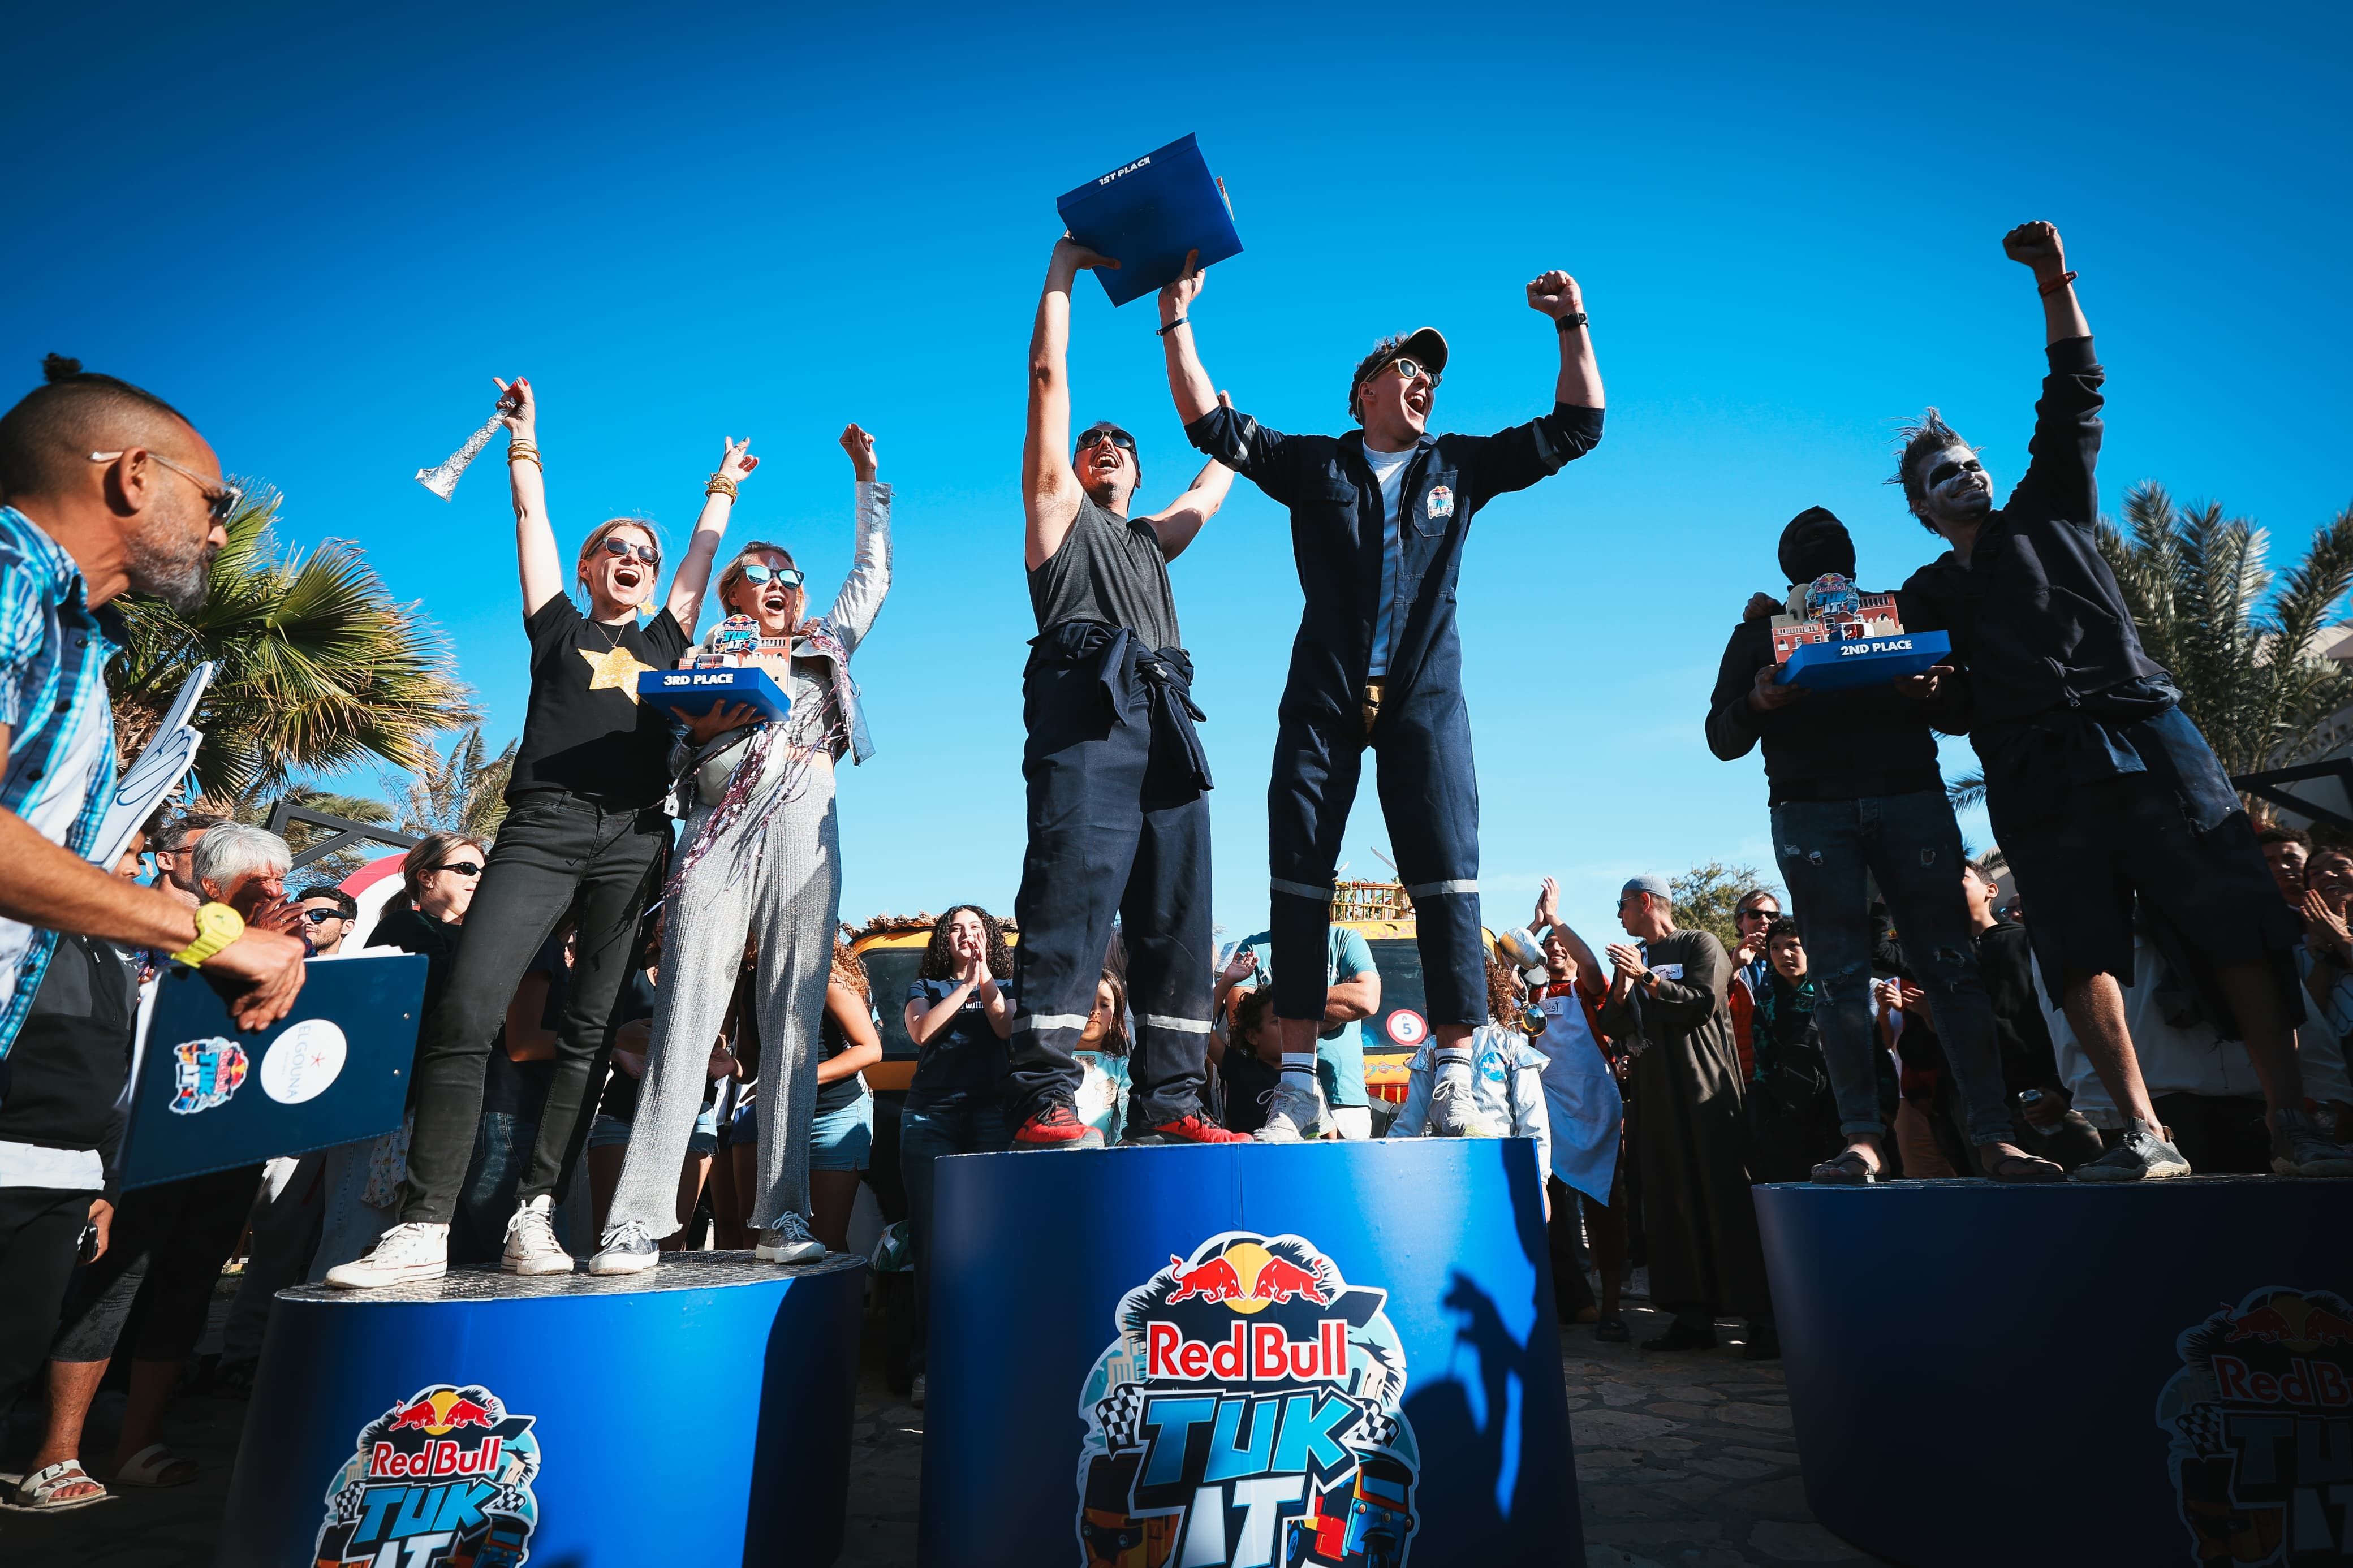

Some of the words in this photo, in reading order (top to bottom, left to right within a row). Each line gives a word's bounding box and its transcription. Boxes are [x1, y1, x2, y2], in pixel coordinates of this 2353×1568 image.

[1098, 172, 1117, 185] 1ST
[1831, 583, 1847, 591] Bull
[1817, 593, 1850, 606] TUK
[1823, 602, 1842, 615] IT
[722, 631, 752, 642] TUK
[726, 640, 744, 650] IT
[1841, 643, 1869, 656] 2ND
[1872, 640, 1912, 652] PLACE
[663, 675, 691, 686] 3RD
[693, 673, 734, 685] PLACE
[298, 1025, 311, 1040] EL
[1403, 1023, 1412, 1035] 5
[218, 1049, 232, 1072] Red
[286, 1042, 308, 1100] GOUNA
[180, 1064, 200, 1088] IT
[197, 1053, 218, 1095] TUK
[214, 1070, 229, 1093] Bull
[1148, 1323, 1244, 1379] Red
[1253, 1320, 1347, 1379] Bull
[2214, 1357, 2312, 1403] Red
[1142, 1394, 1356, 1487] TUK
[2230, 1417, 2353, 1484] TU
[369, 1441, 433, 1476] Red
[436, 1437, 502, 1475] Bull
[352, 1483, 497, 1544] TUK
[1184, 1475, 1306, 1568] IT
